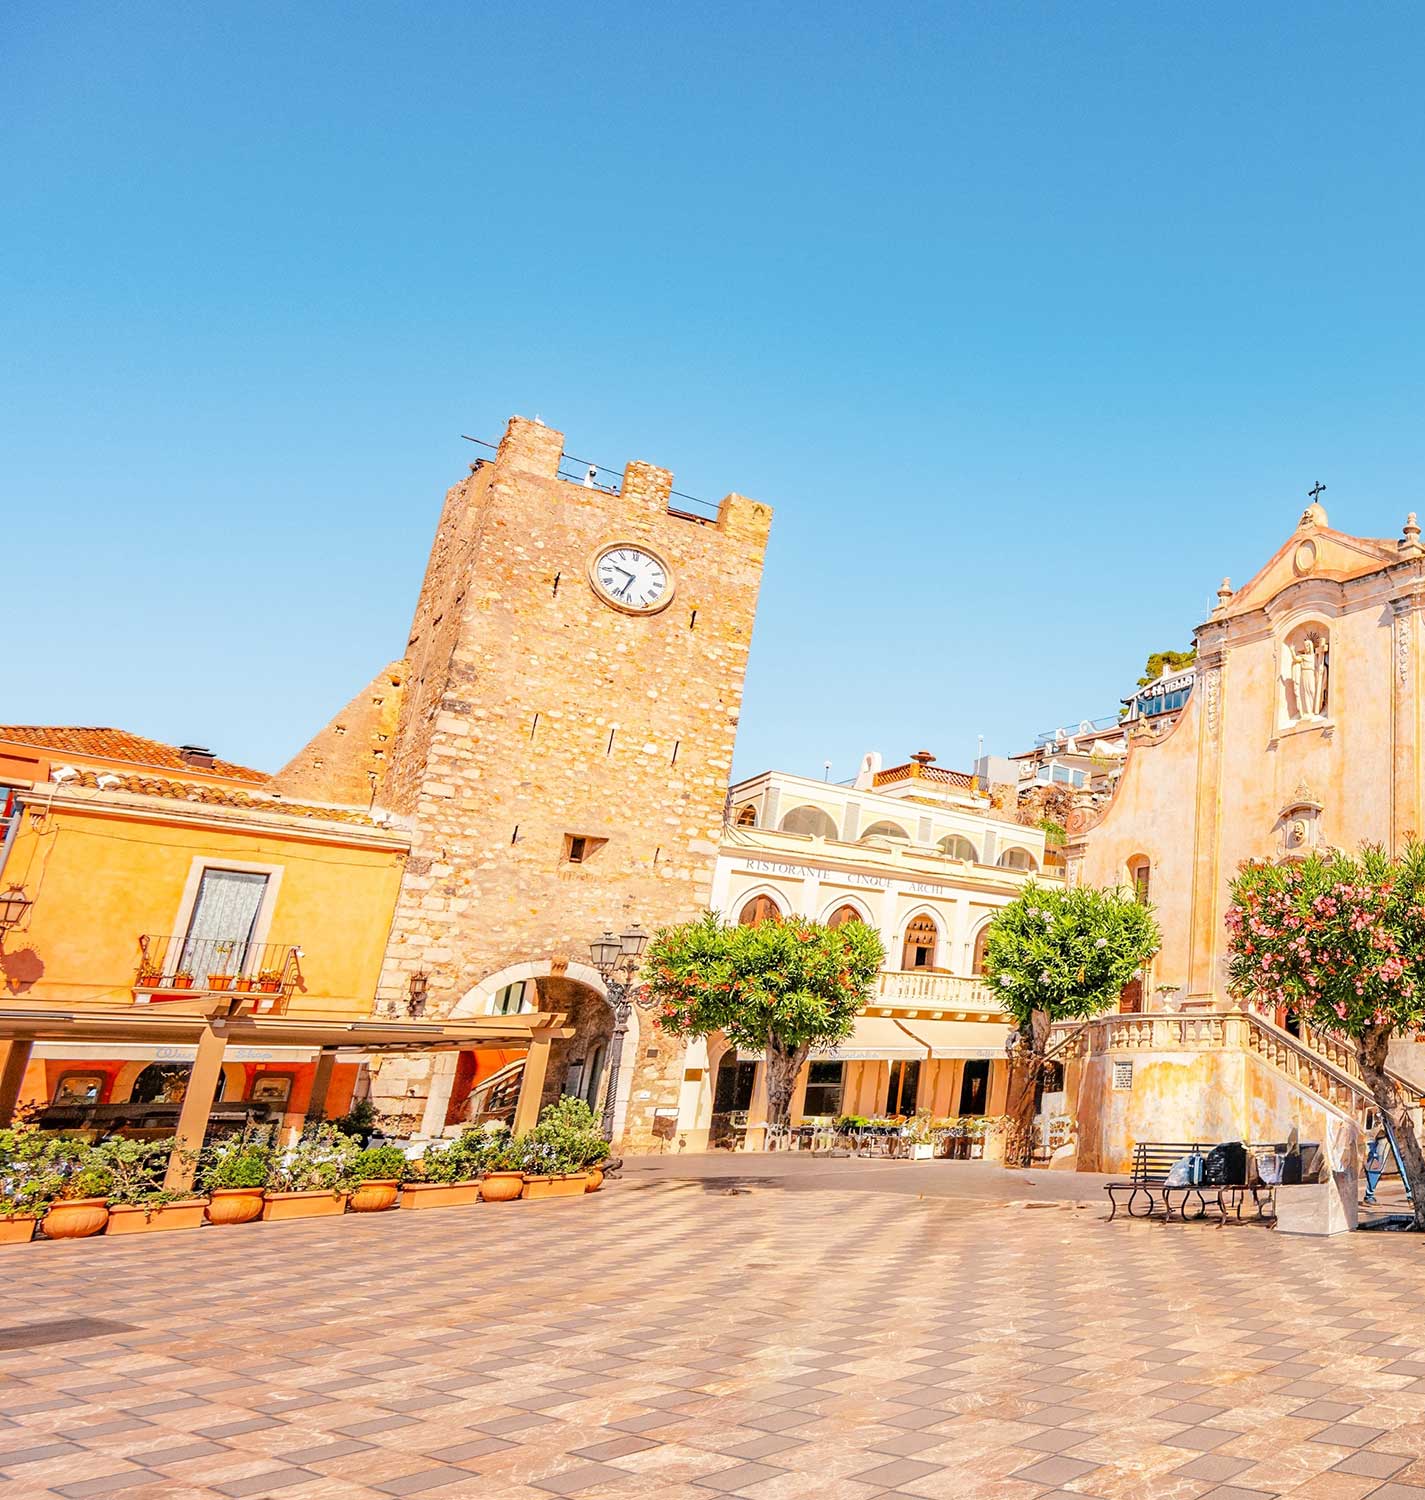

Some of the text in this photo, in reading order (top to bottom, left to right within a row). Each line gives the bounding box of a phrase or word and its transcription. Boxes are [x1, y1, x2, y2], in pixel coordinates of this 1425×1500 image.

[746, 858, 943, 895] RISTORANTE CINQUE ARCHI
